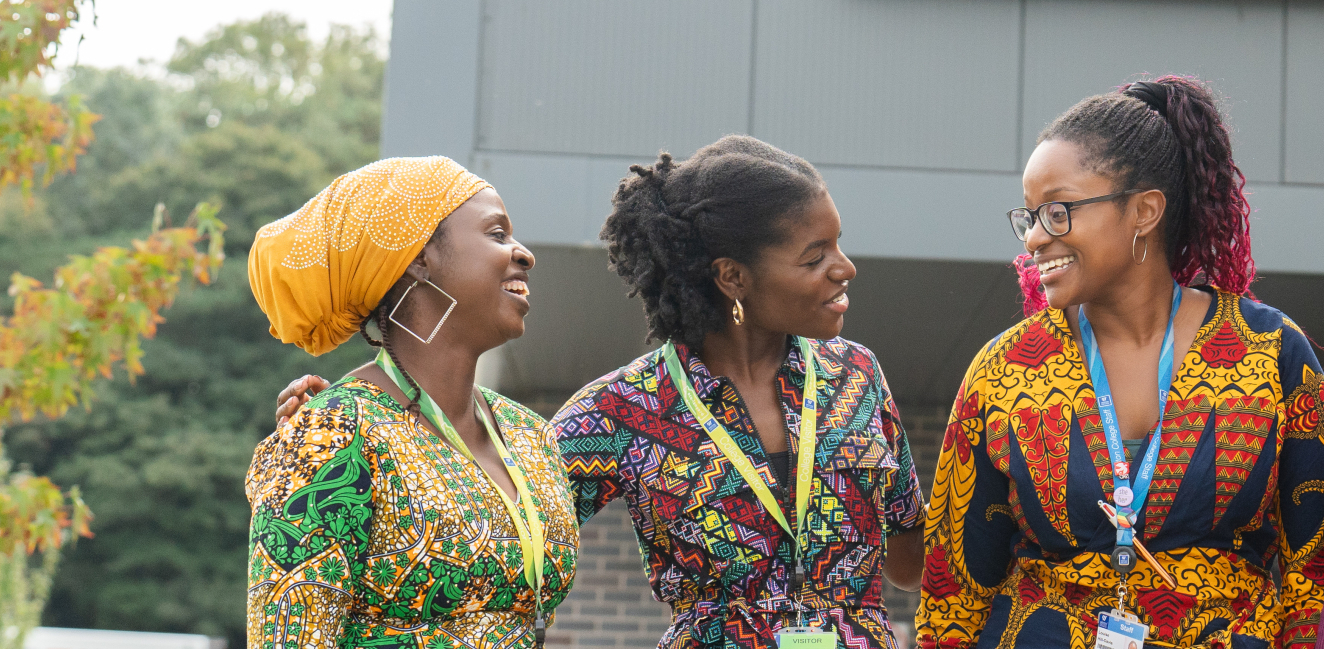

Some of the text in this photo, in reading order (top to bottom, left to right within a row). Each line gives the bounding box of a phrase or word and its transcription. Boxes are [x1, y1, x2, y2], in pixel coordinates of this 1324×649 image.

[1103, 409, 1113, 424] Staff
[806, 418, 814, 445] Visitor
[1109, 425, 1119, 449] College
[719, 436, 764, 492] College Visitor
[800, 446, 813, 482] College
[1141, 463, 1152, 480] Staff
[513, 509, 528, 540] Visitor
[527, 501, 541, 536] College
[1120, 624, 1134, 633] Staff
